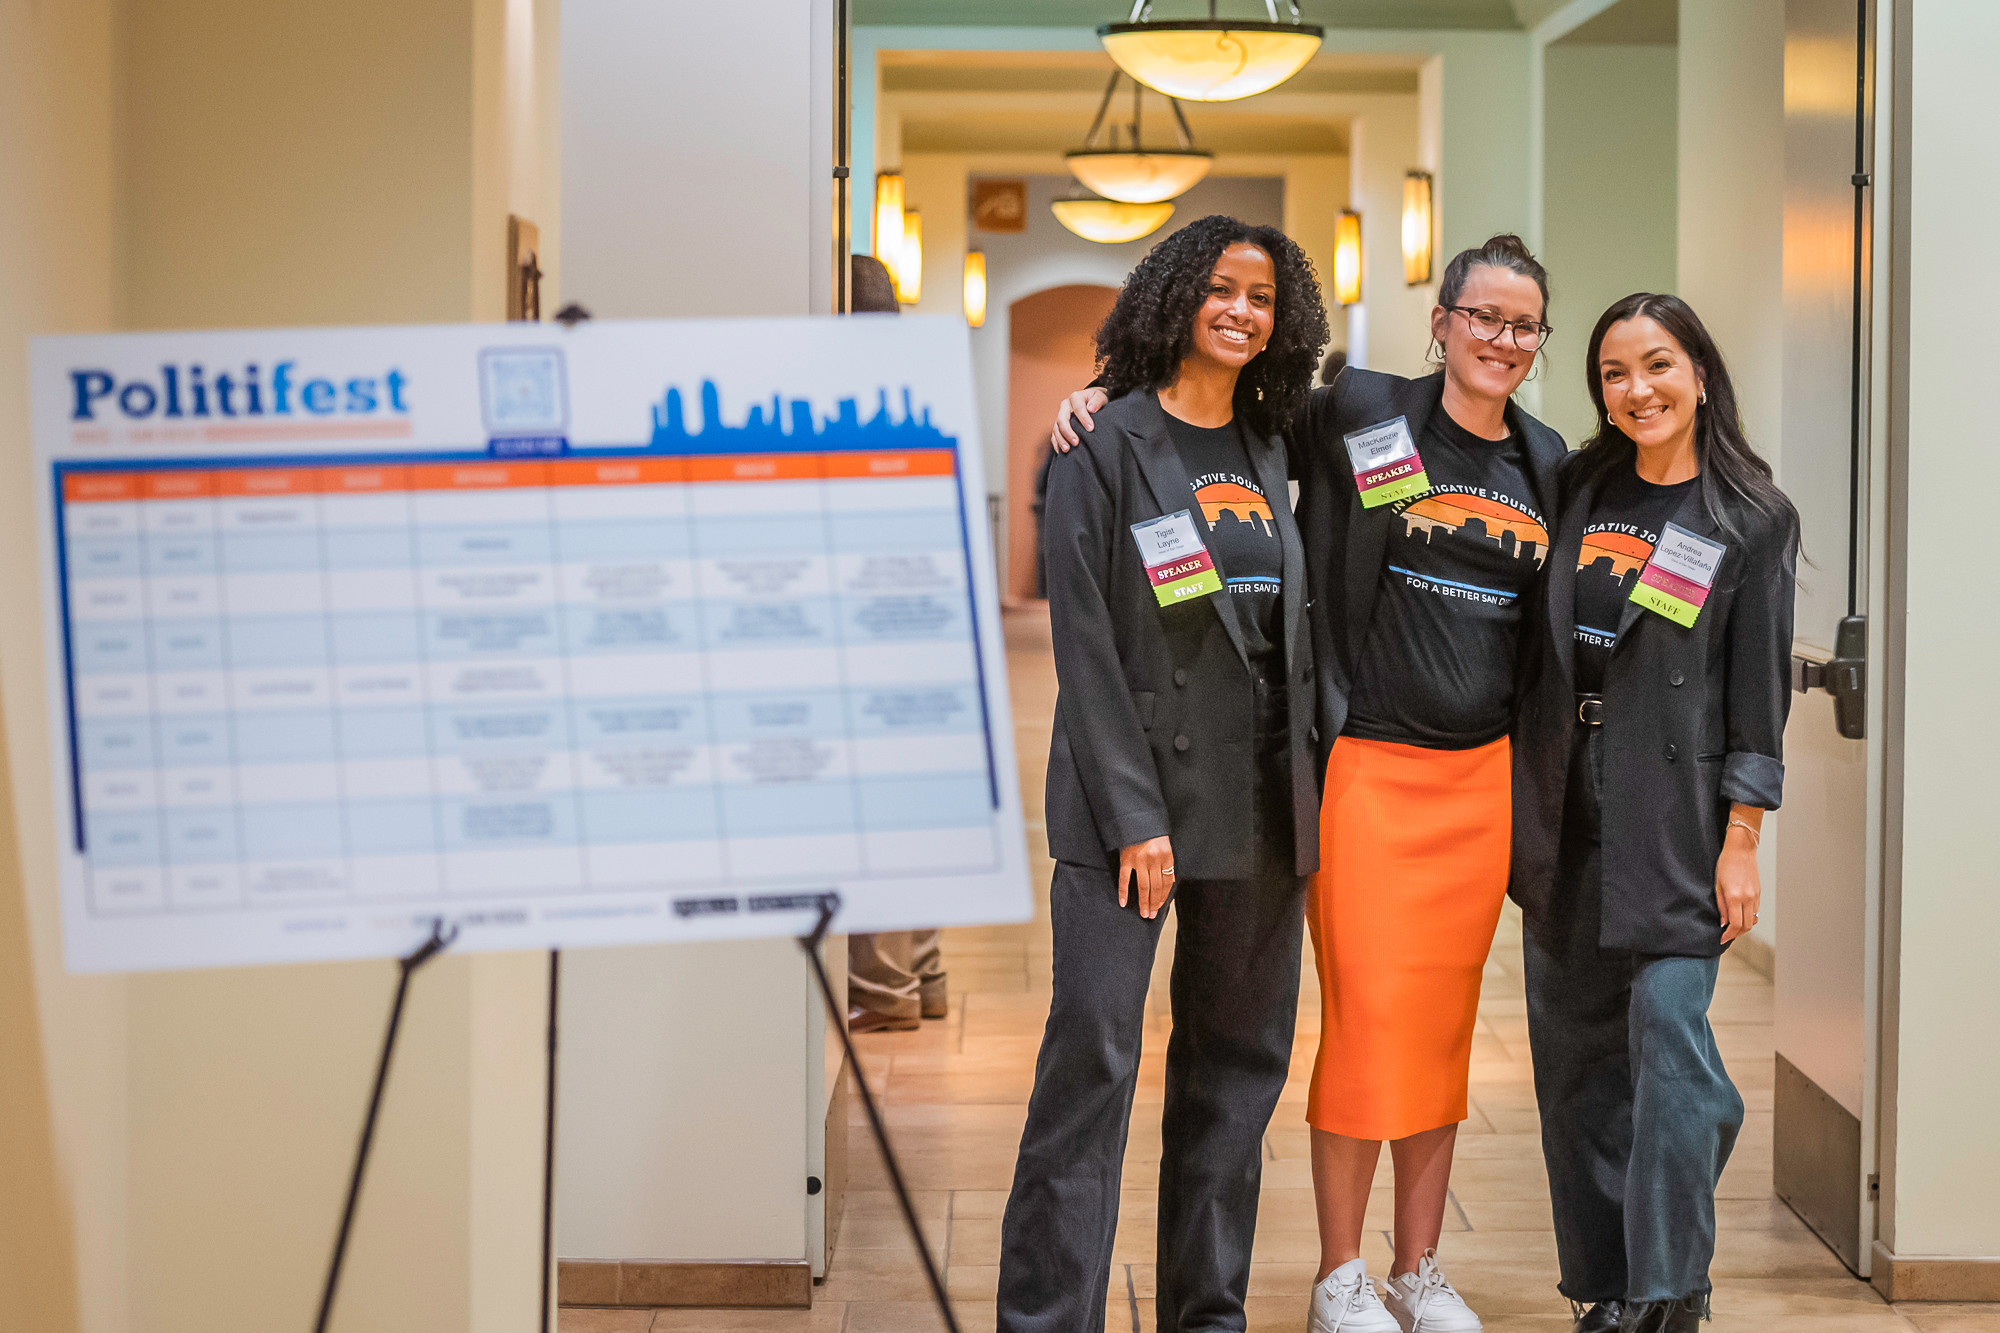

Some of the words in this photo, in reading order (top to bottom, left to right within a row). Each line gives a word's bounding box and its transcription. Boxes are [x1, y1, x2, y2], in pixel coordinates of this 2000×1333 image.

[70, 360, 410, 421] Politifest
[1357, 431, 1399, 449] MacKenzie
[1370, 443, 1392, 455] Elmer
[1365, 463, 1412, 485] SPEAKER
[1391, 484, 1487, 514] INVESTIGATIVE
[1155, 527, 1175, 538] Tigist
[1639, 529, 1659, 545] JO
[1157, 537, 1180, 549] Layne
[1676, 541, 1703, 557] Andrea
[1157, 559, 1202, 580] SPEAKER
[1173, 582, 1204, 598] STAFF
[1254, 584, 1270, 593] SAN
[1407, 577, 1429, 591] FOR
[1431, 584, 1440, 594] A
[1443, 587, 1479, 602] BETTER
[1482, 594, 1498, 605] SAN
[1648, 596, 1681, 615] STAFF
